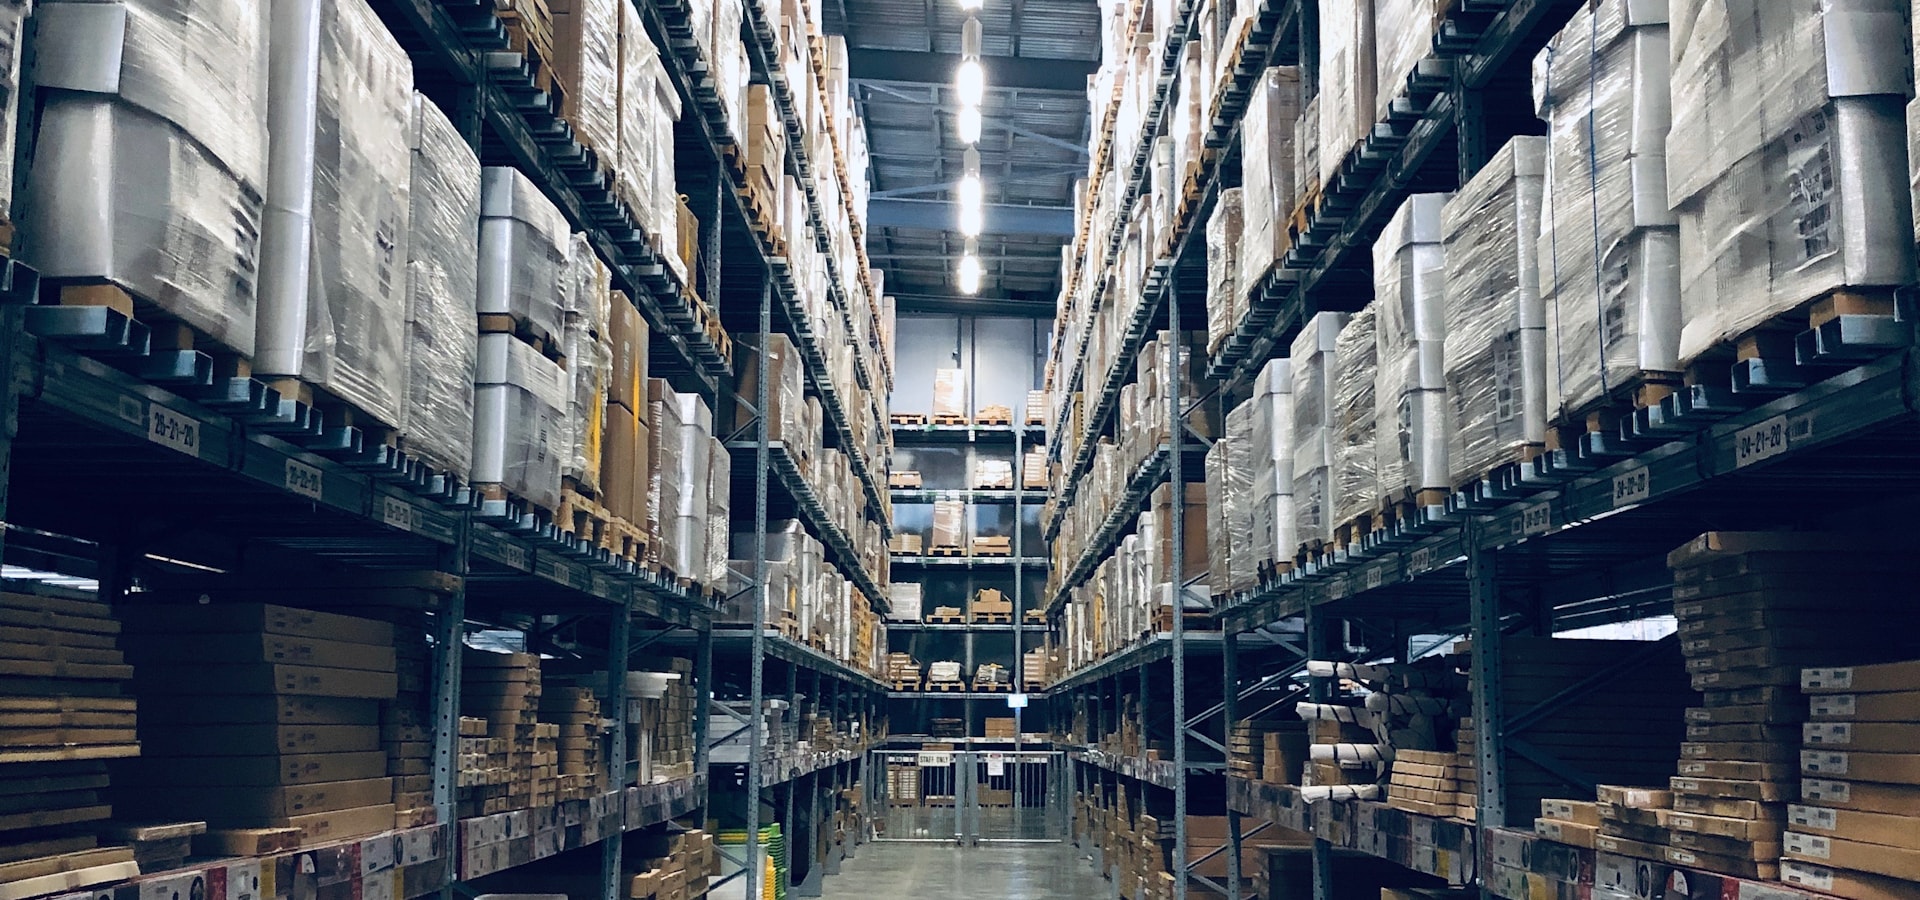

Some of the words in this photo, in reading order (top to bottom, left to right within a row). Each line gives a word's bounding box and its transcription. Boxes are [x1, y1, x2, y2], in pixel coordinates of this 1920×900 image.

[1741, 423, 1782, 458] 24-21-20
[920, 755, 934, 763] STAFF
[936, 756, 948, 764] ONLY
